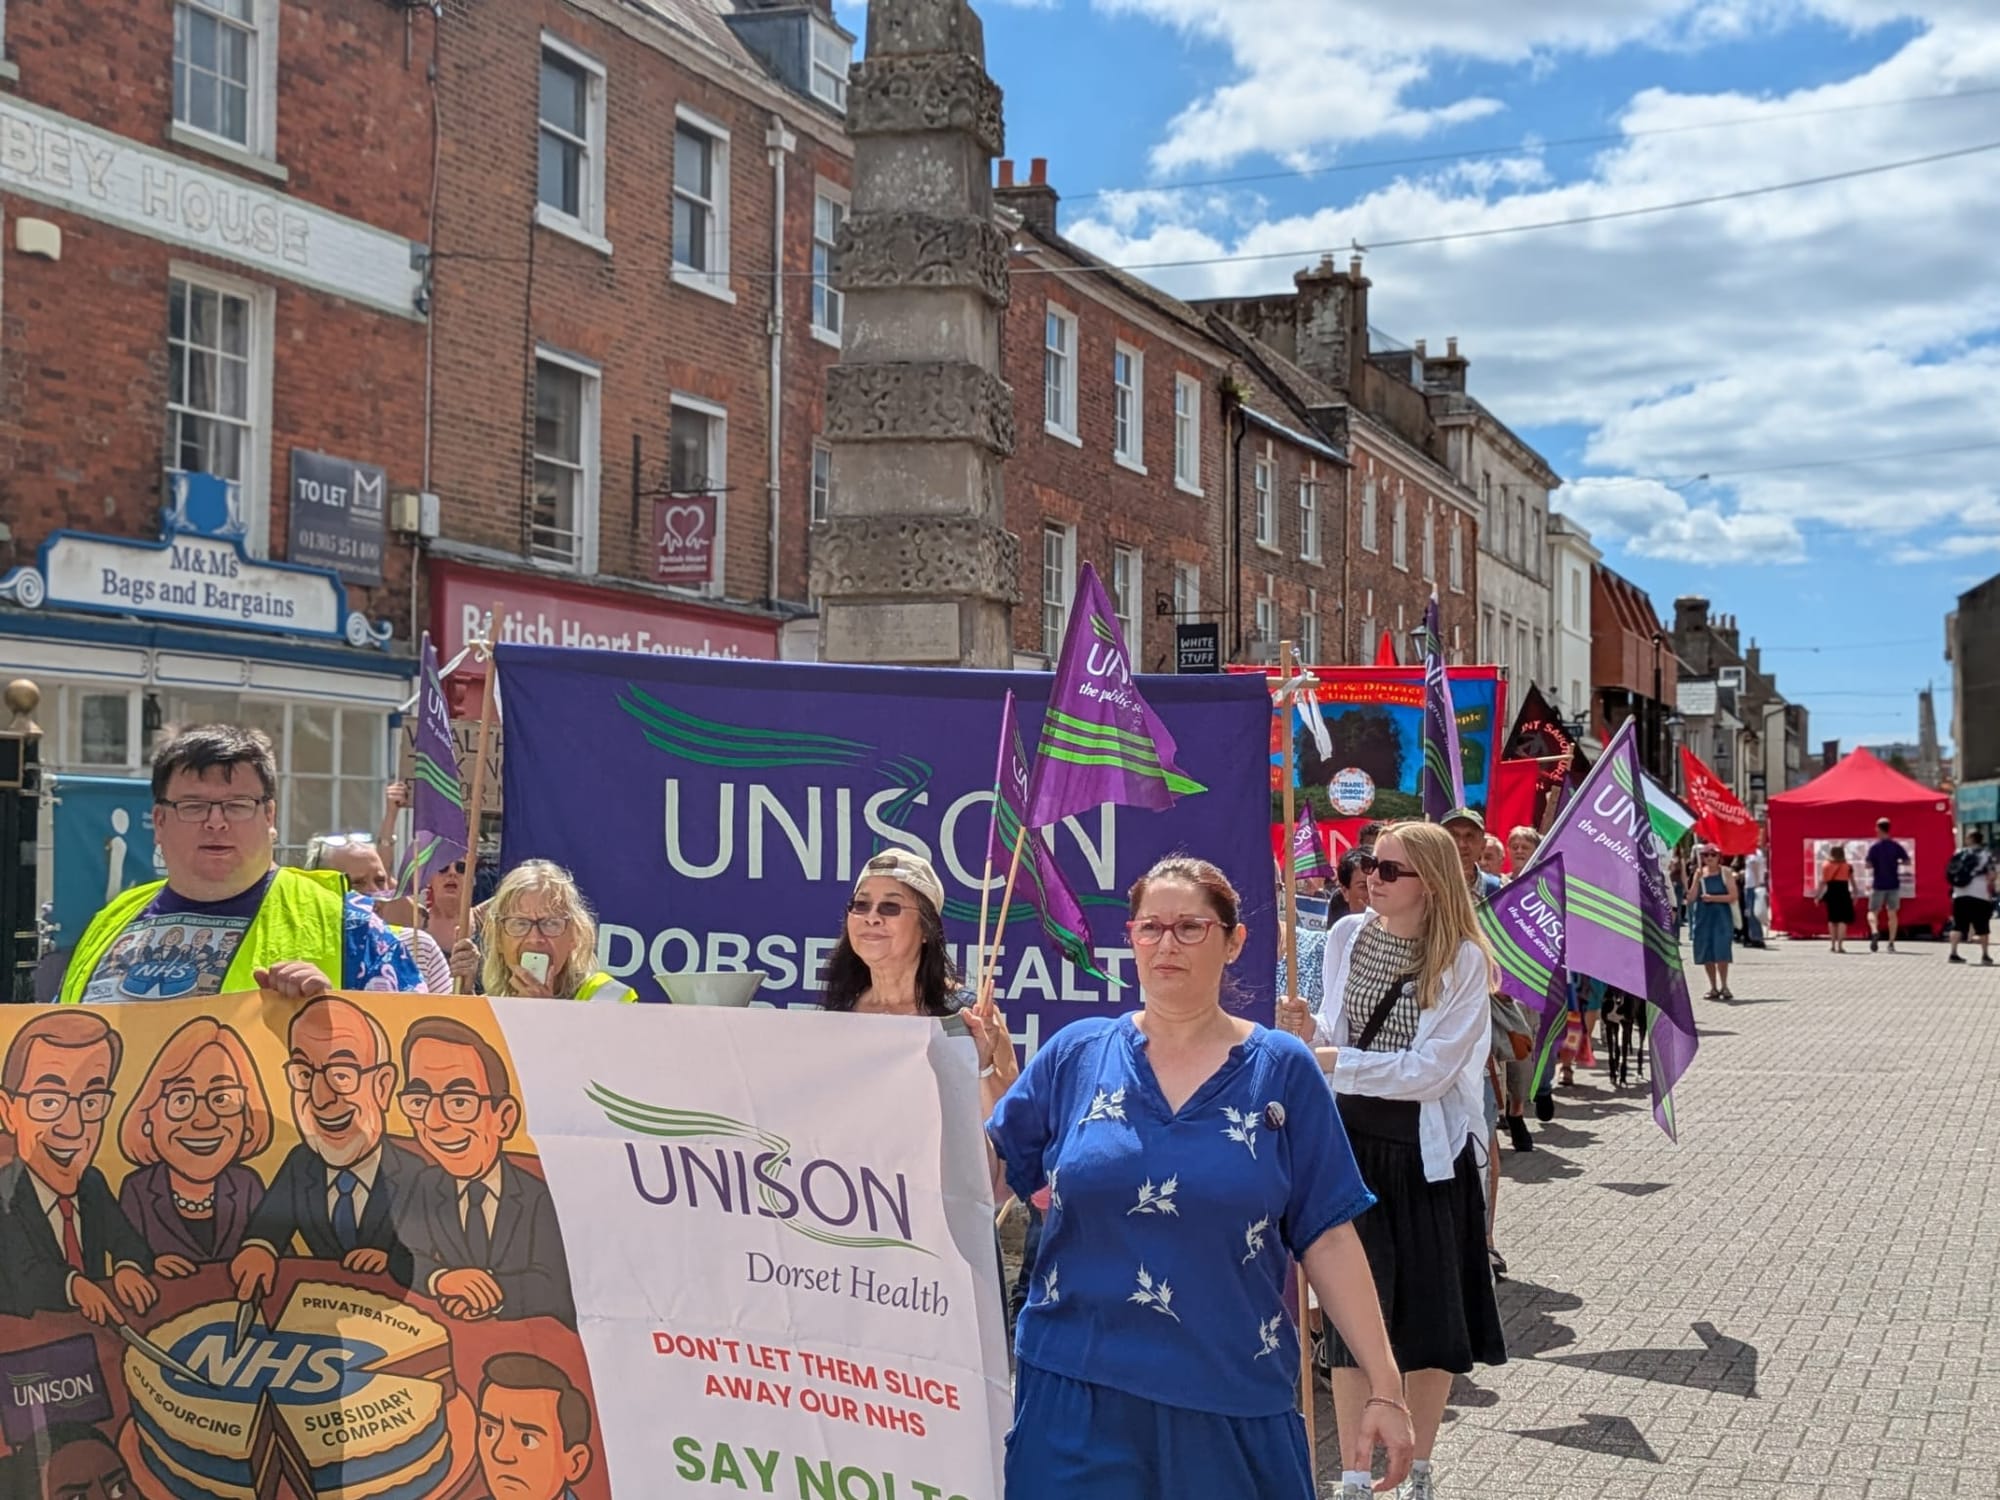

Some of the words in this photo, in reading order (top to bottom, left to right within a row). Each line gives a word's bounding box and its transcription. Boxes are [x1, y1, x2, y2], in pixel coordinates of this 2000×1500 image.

[141, 164, 310, 267] HOUSE
[297, 477, 320, 502] TO
[322, 483, 347, 508] LET
[169, 545, 240, 578] M&M's
[101, 568, 155, 604] Bags
[159, 580, 197, 605] and
[204, 583, 294, 619] Bargains
[1180, 637, 1214, 649] WHITE
[1181, 653, 1214, 666] STUFF
[1079, 681, 1098, 698] the
[1099, 689, 1131, 708] public
[1327, 692, 1372, 701] Union
[1364, 682, 1421, 694] District
[1577, 819, 1597, 836] the
[1594, 832, 1634, 863] public
[1507, 906, 1520, 919] the
[1515, 918, 1537, 939] public
[1533, 938, 1556, 959] service
[134, 964, 190, 979] NHS
[625, 1143, 911, 1240] UNISON
[746, 1252, 841, 1294] Dorset
[850, 1266, 949, 1317] Health
[303, 1297, 421, 1337] PRIVATISATION
[172, 1335, 355, 1394] NHS
[653, 1332, 740, 1363] DON'T
[746, 1344, 791, 1373] LET
[799, 1352, 878, 1390] THEM
[884, 1369, 961, 1411] SLICE
[13, 1373, 94, 1406] UNISON
[132, 1366, 242, 1437] OUTSOURCING
[304, 1387, 414, 1432] SUBSIDIARY
[705, 1375, 791, 1408] AWAY
[800, 1389, 859, 1423] OUR
[866, 1404, 926, 1437] NHS
[321, 1408, 417, 1447] COMPANY
[672, 1436, 780, 1493] SAY
